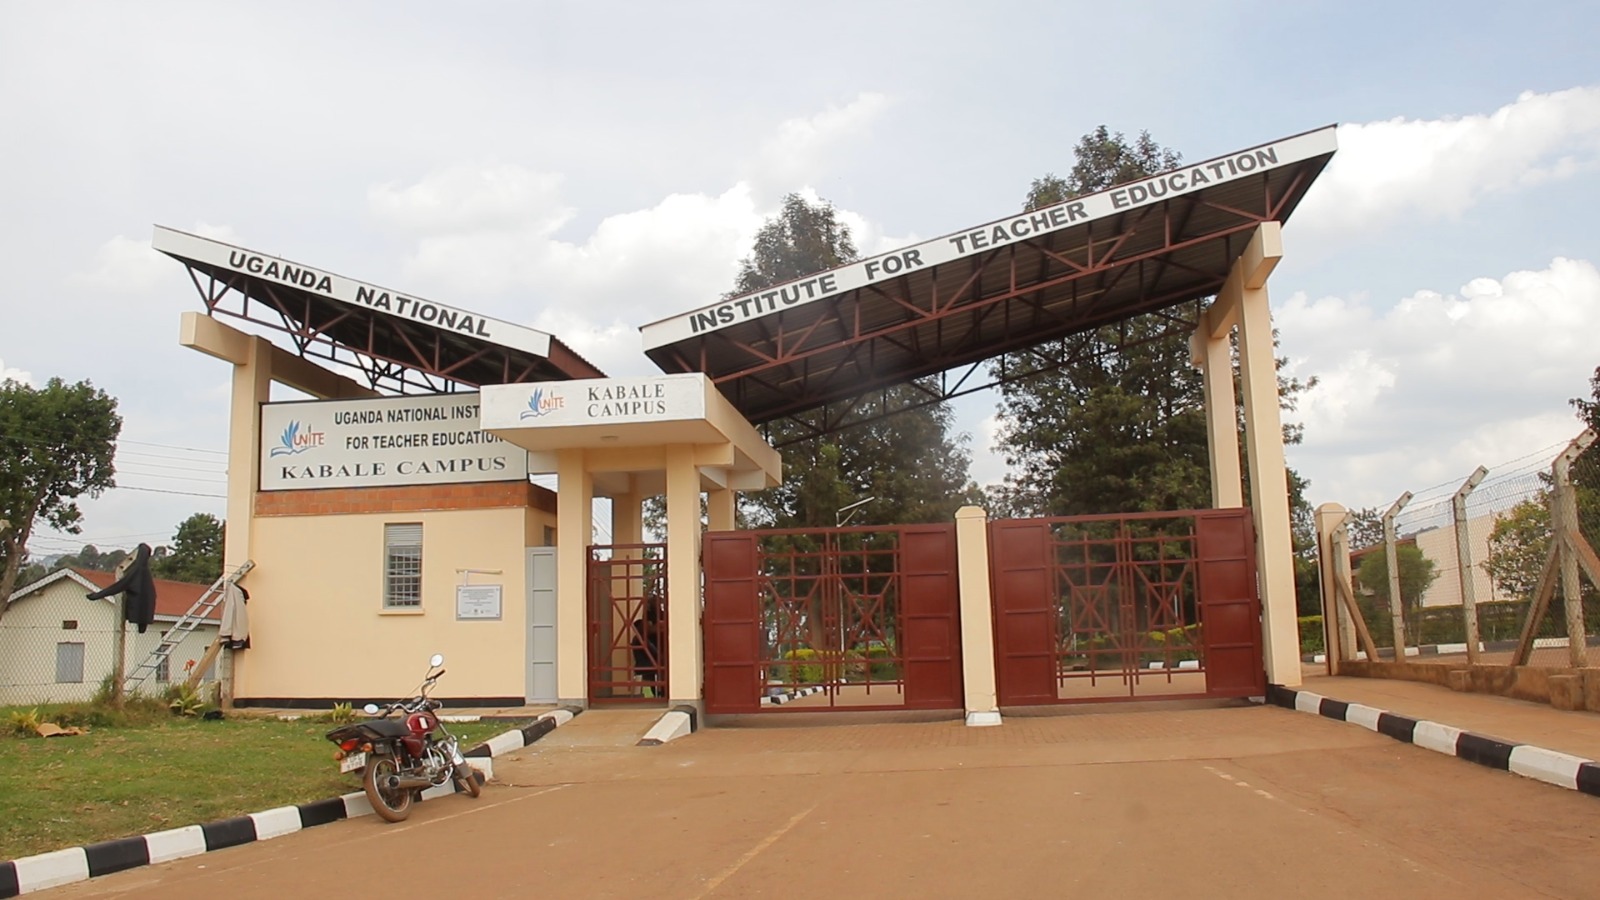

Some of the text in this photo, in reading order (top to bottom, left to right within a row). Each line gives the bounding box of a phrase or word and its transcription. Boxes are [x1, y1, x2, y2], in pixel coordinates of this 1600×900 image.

[689, 146, 1279, 334] INSTITUTE FOR TEACHER EDUCATION
[228, 250, 491, 339] UGANDA NATIONAL
[587, 384, 665, 401] KABALE
[539, 396, 565, 409] UNITE
[587, 400, 666, 418] CAMPUS
[334, 410, 384, 425] UGANDA
[387, 407, 448, 423] NATIONAL
[293, 430, 325, 446] UNITE
[346, 436, 369, 450] FOR
[372, 433, 429, 449] TEACHER
[281, 456, 507, 479] KABALE CAMPUS
